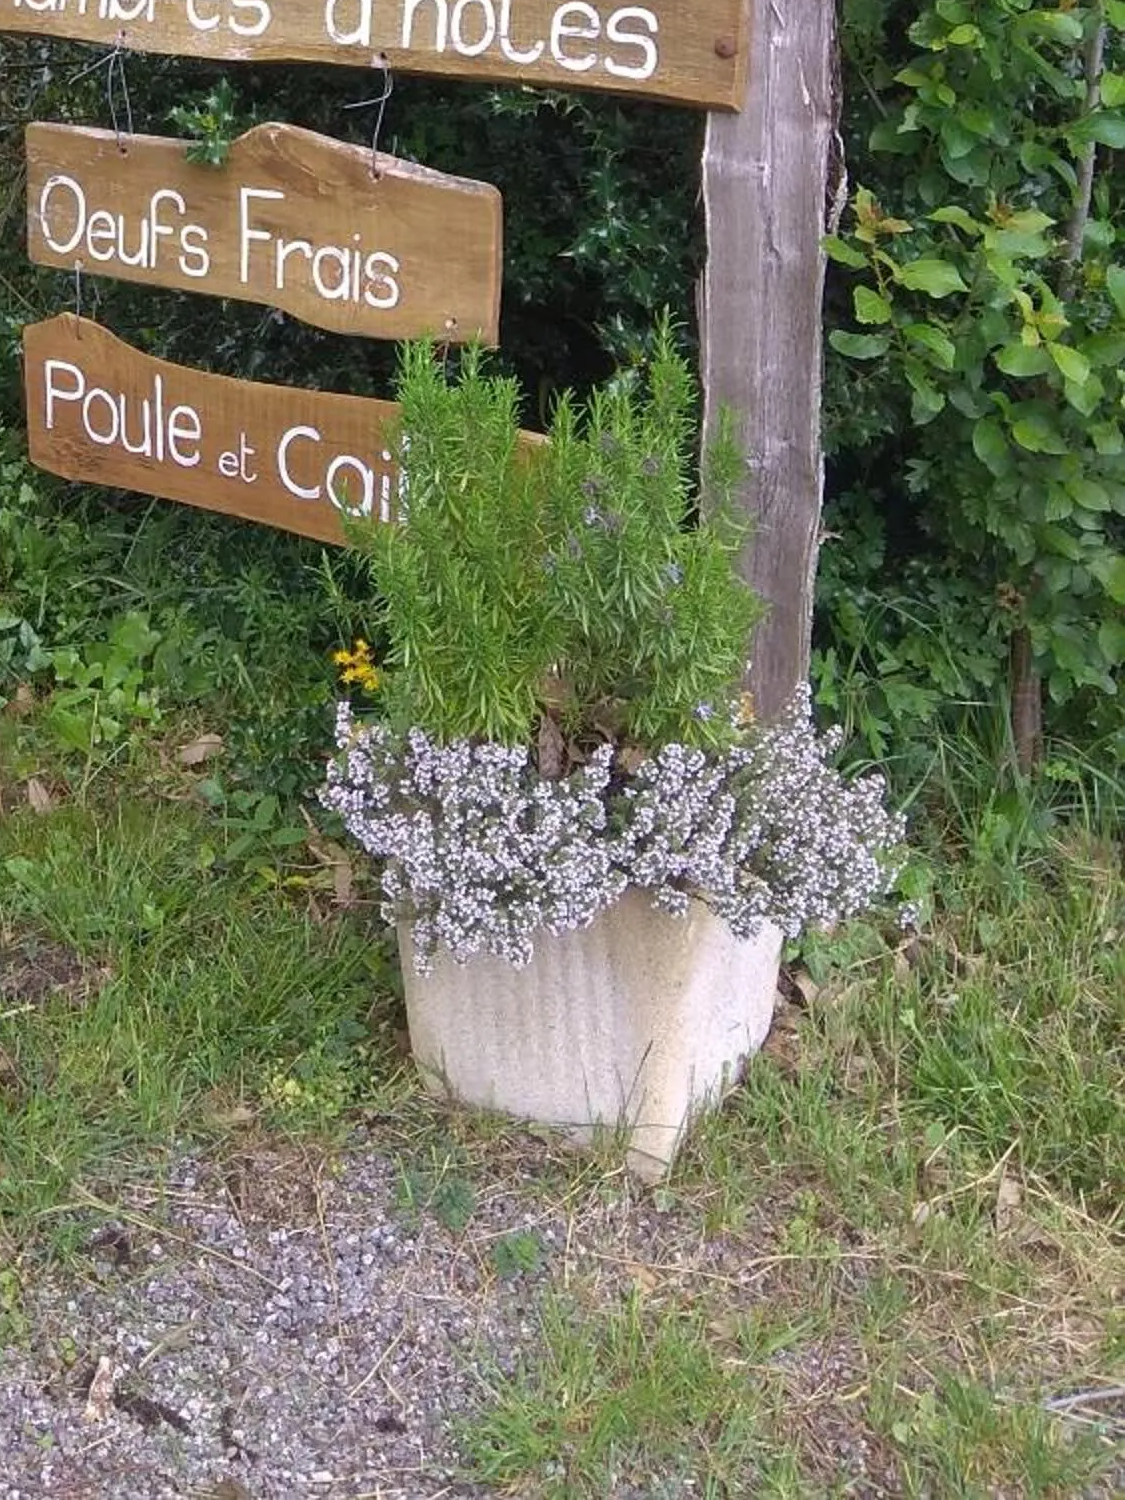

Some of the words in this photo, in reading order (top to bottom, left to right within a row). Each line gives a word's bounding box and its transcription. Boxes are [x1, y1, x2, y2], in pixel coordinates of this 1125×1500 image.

[39, 174, 210, 278] Oeufs
[239, 186, 400, 309] Frais
[44, 359, 202, 467] Poule
[217, 433, 257, 484] et
